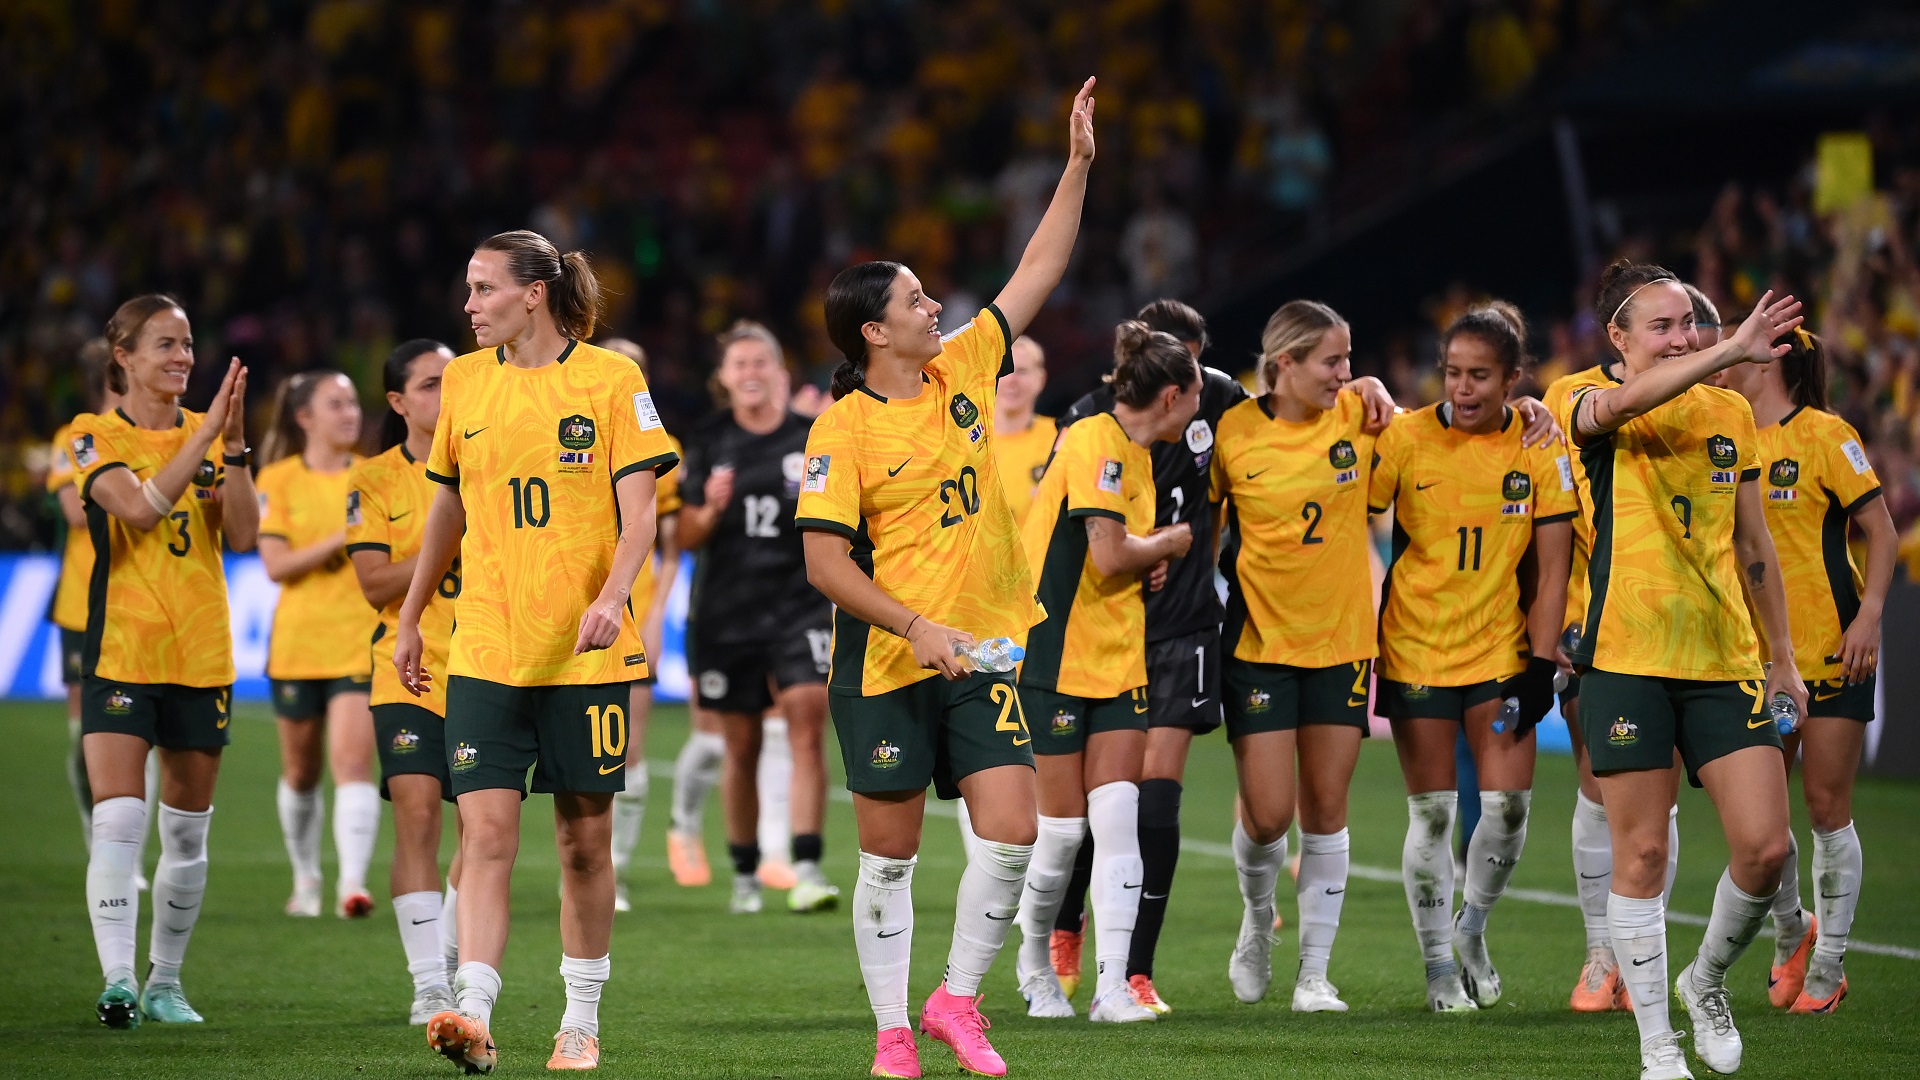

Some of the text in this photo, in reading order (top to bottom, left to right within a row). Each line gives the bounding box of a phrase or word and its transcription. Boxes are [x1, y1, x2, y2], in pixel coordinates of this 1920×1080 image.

[508, 477, 551, 529] 10
[744, 495, 780, 537] 12
[940, 466, 981, 528] 20
[168, 511, 191, 557] 3
[1302, 502, 1323, 545] 2
[1456, 527, 1482, 571] 11
[1195, 646, 1204, 693] 1
[1352, 661, 1367, 696] 2
[1738, 680, 1764, 714] 9
[585, 704, 626, 757] 10
[99, 898, 129, 909] AUS
[1418, 898, 1445, 909] AUS
